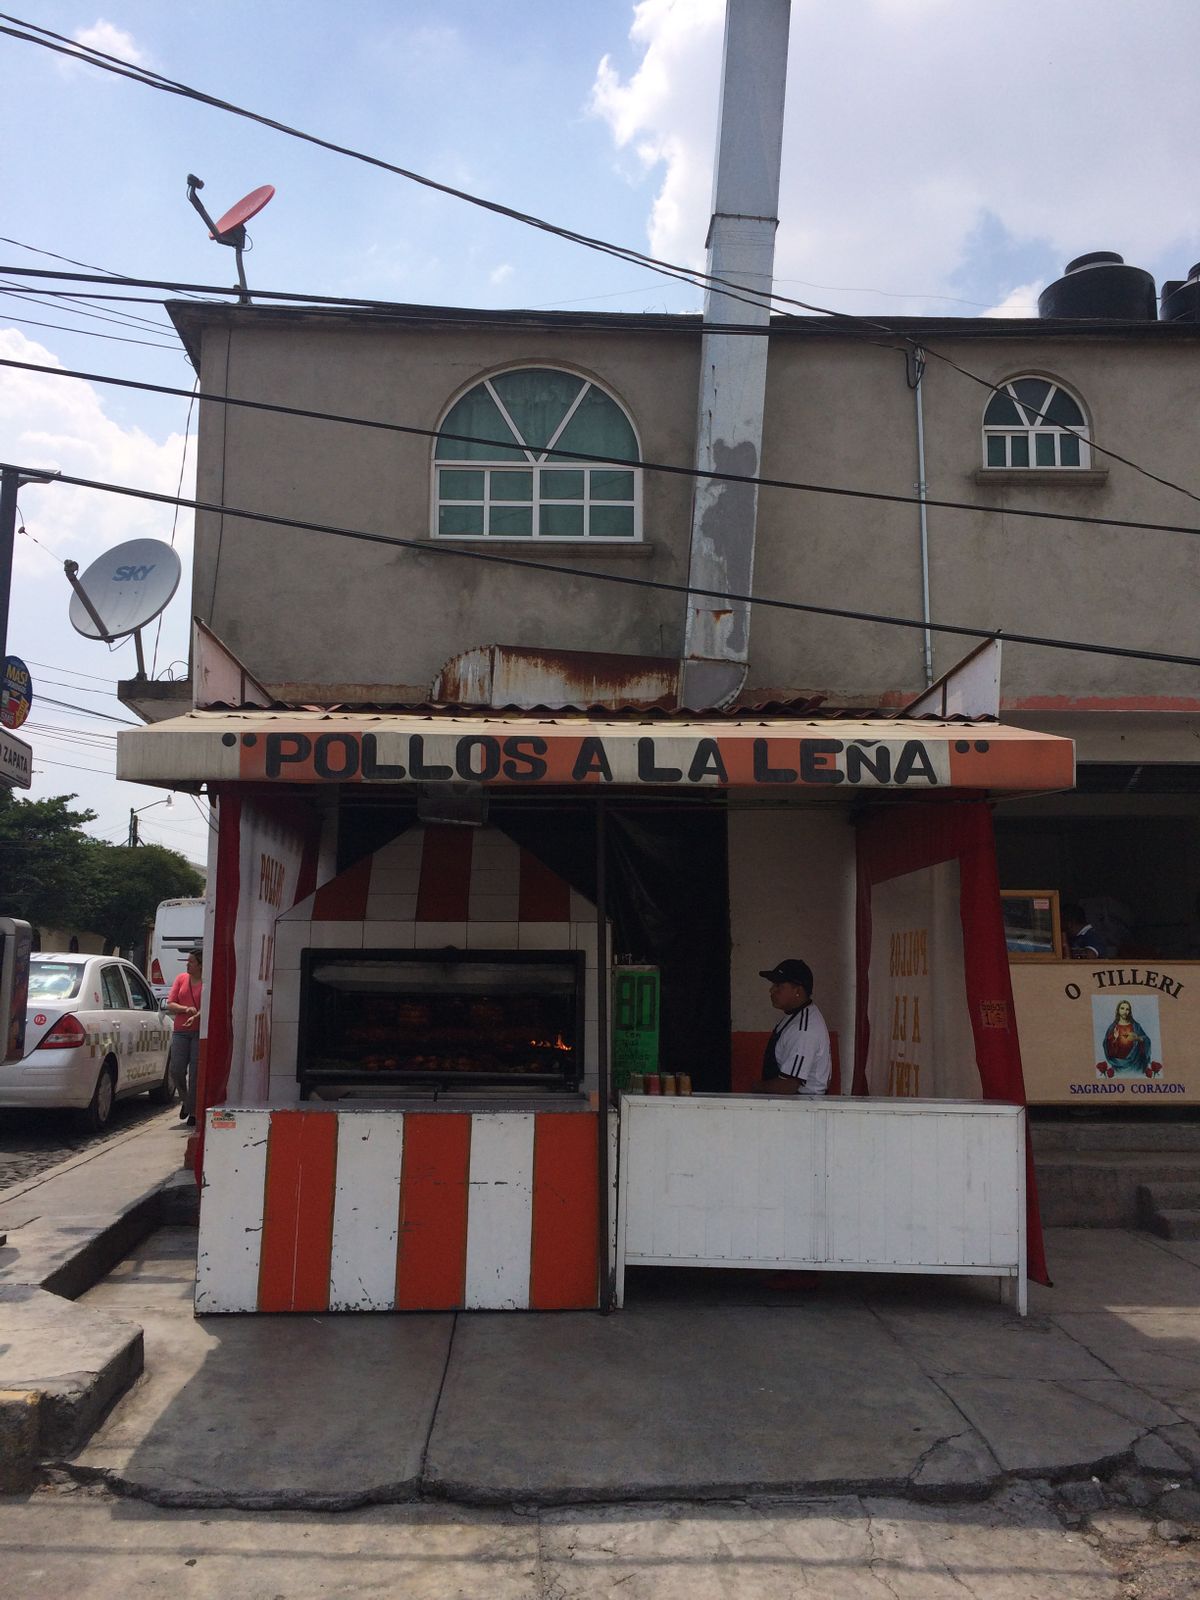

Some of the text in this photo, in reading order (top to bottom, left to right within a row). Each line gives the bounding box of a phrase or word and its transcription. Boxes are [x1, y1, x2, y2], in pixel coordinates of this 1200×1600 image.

[113, 565, 156, 583] SKY
[3, 746, 28, 774] ZAPATA
[265, 732, 938, 786] POLLOS A LA LEÑA
[1064, 967, 1185, 1001] O TILLERI
[1069, 1083, 1186, 1095] SAGRADO CORAZON
